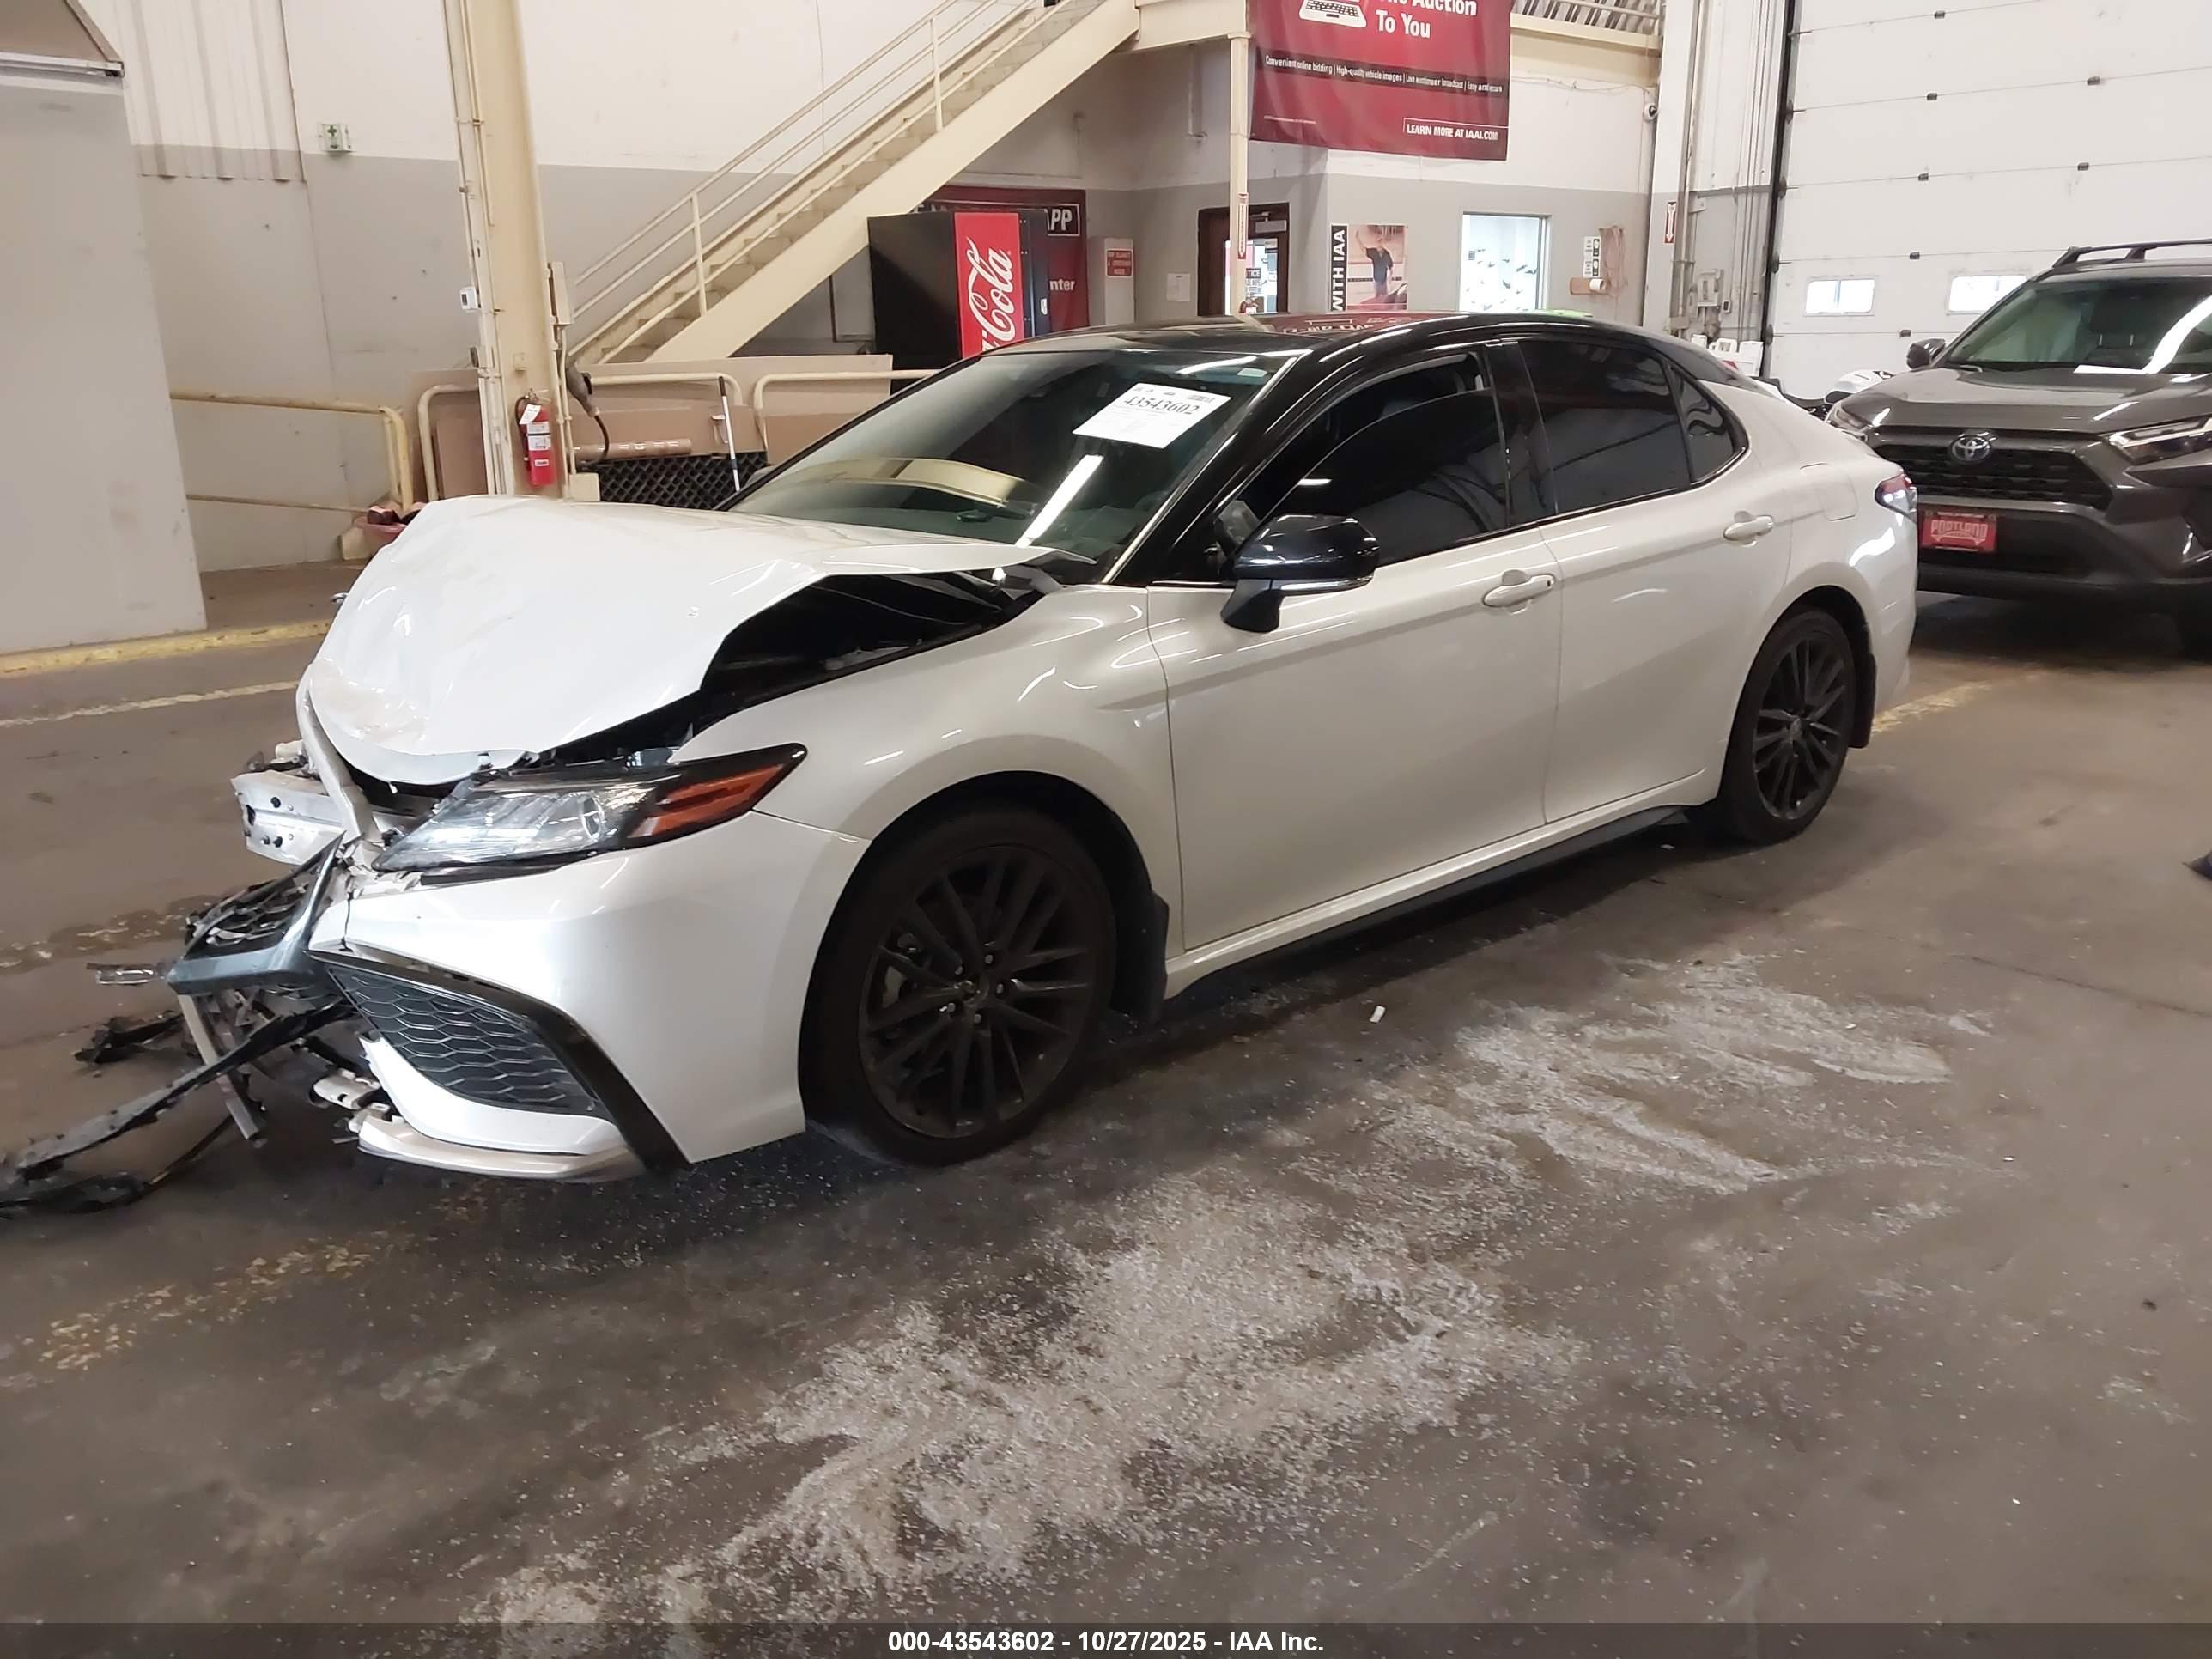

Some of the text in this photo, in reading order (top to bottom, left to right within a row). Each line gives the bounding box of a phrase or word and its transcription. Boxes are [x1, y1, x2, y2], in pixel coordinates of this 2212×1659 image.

[1376, 9, 1431, 39] To You
[1265, 55, 1297, 68] Convenient
[1297, 60, 1311, 70] online
[1312, 62, 1333, 75] bidding
[1382, 72, 1402, 83] images
[1407, 124, 1432, 136] LEARN
[1433, 126, 1454, 137] MORE
[1455, 128, 1464, 138] AT
[1332, 229, 1346, 311] WITH IAA
[1049, 278, 1075, 291] nter
[1123, 395, 1200, 415] 43543602
